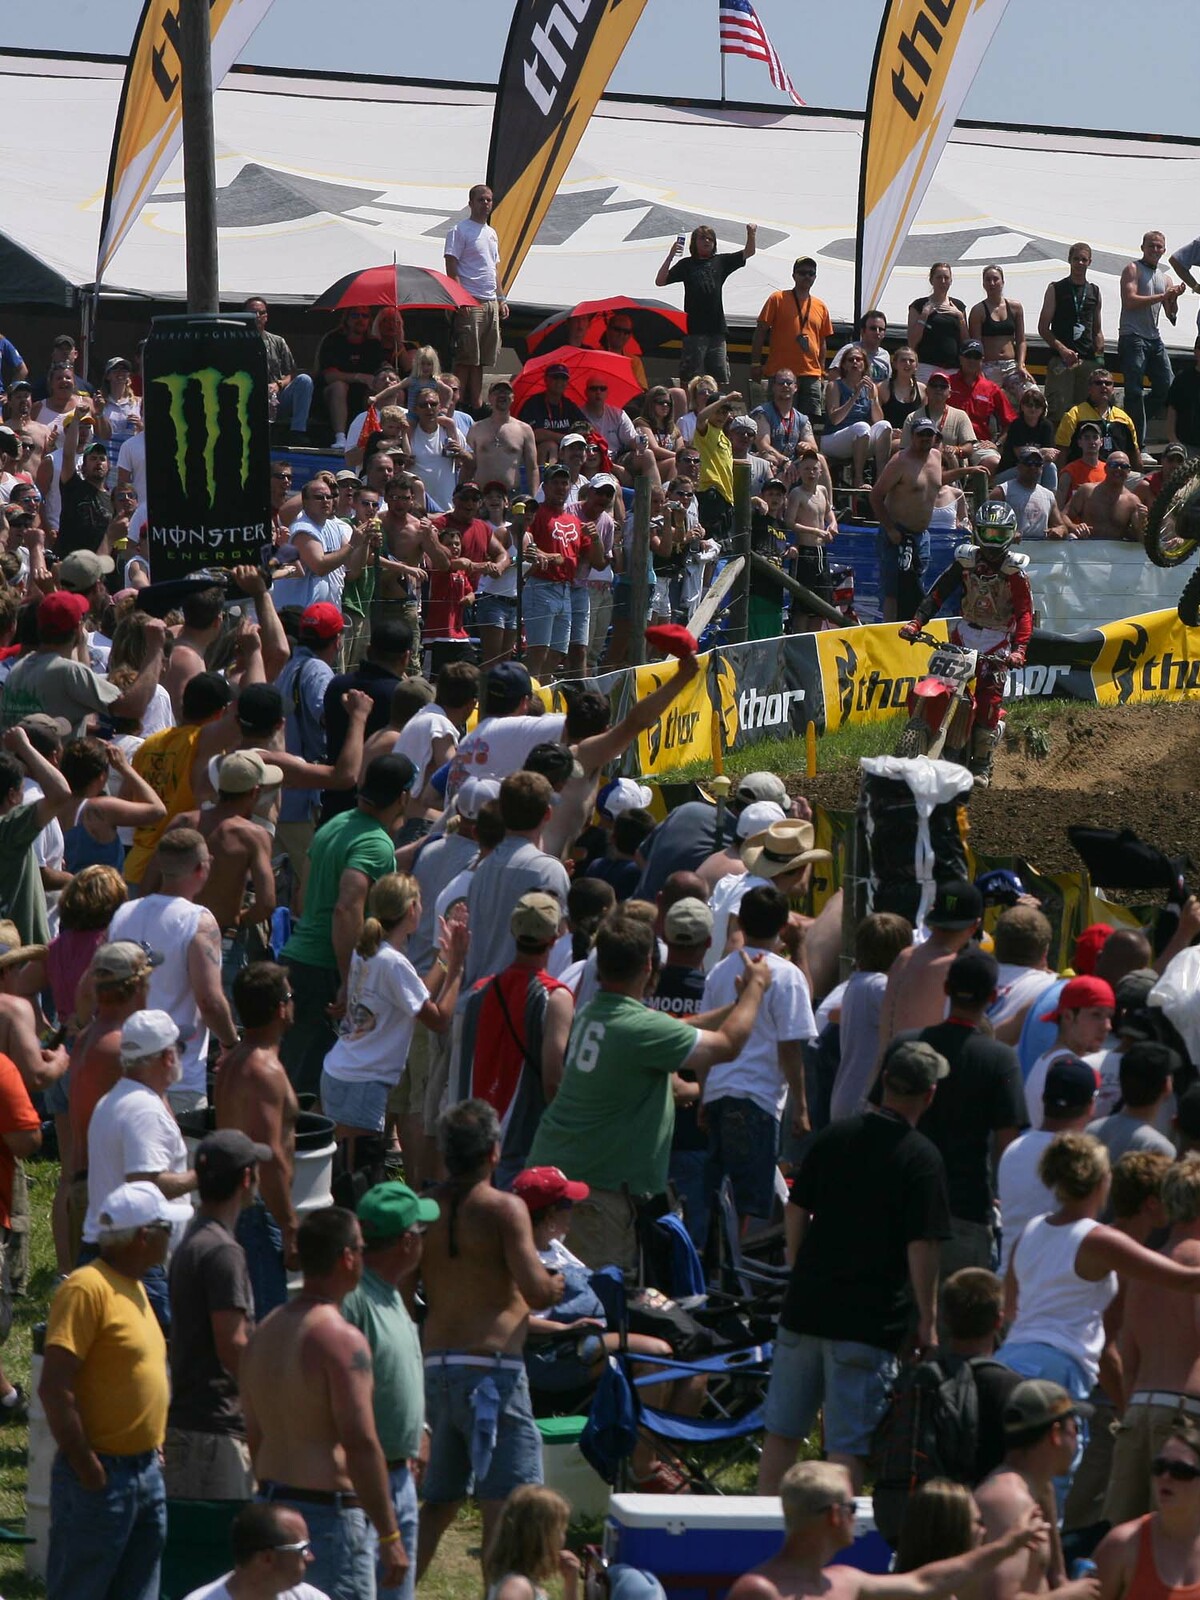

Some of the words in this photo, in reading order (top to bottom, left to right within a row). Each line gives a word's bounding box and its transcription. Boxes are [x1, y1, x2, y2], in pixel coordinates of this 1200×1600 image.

[152, 522, 267, 548] MONSTER
[167, 549, 256, 561] ENERGY
[929, 656, 972, 680] 662
[1003, 664, 1071, 698] hor
[856, 670, 926, 711] tho
[739, 688, 806, 730] thor
[664, 706, 700, 749] thor
[648, 996, 702, 1013] MOORE
